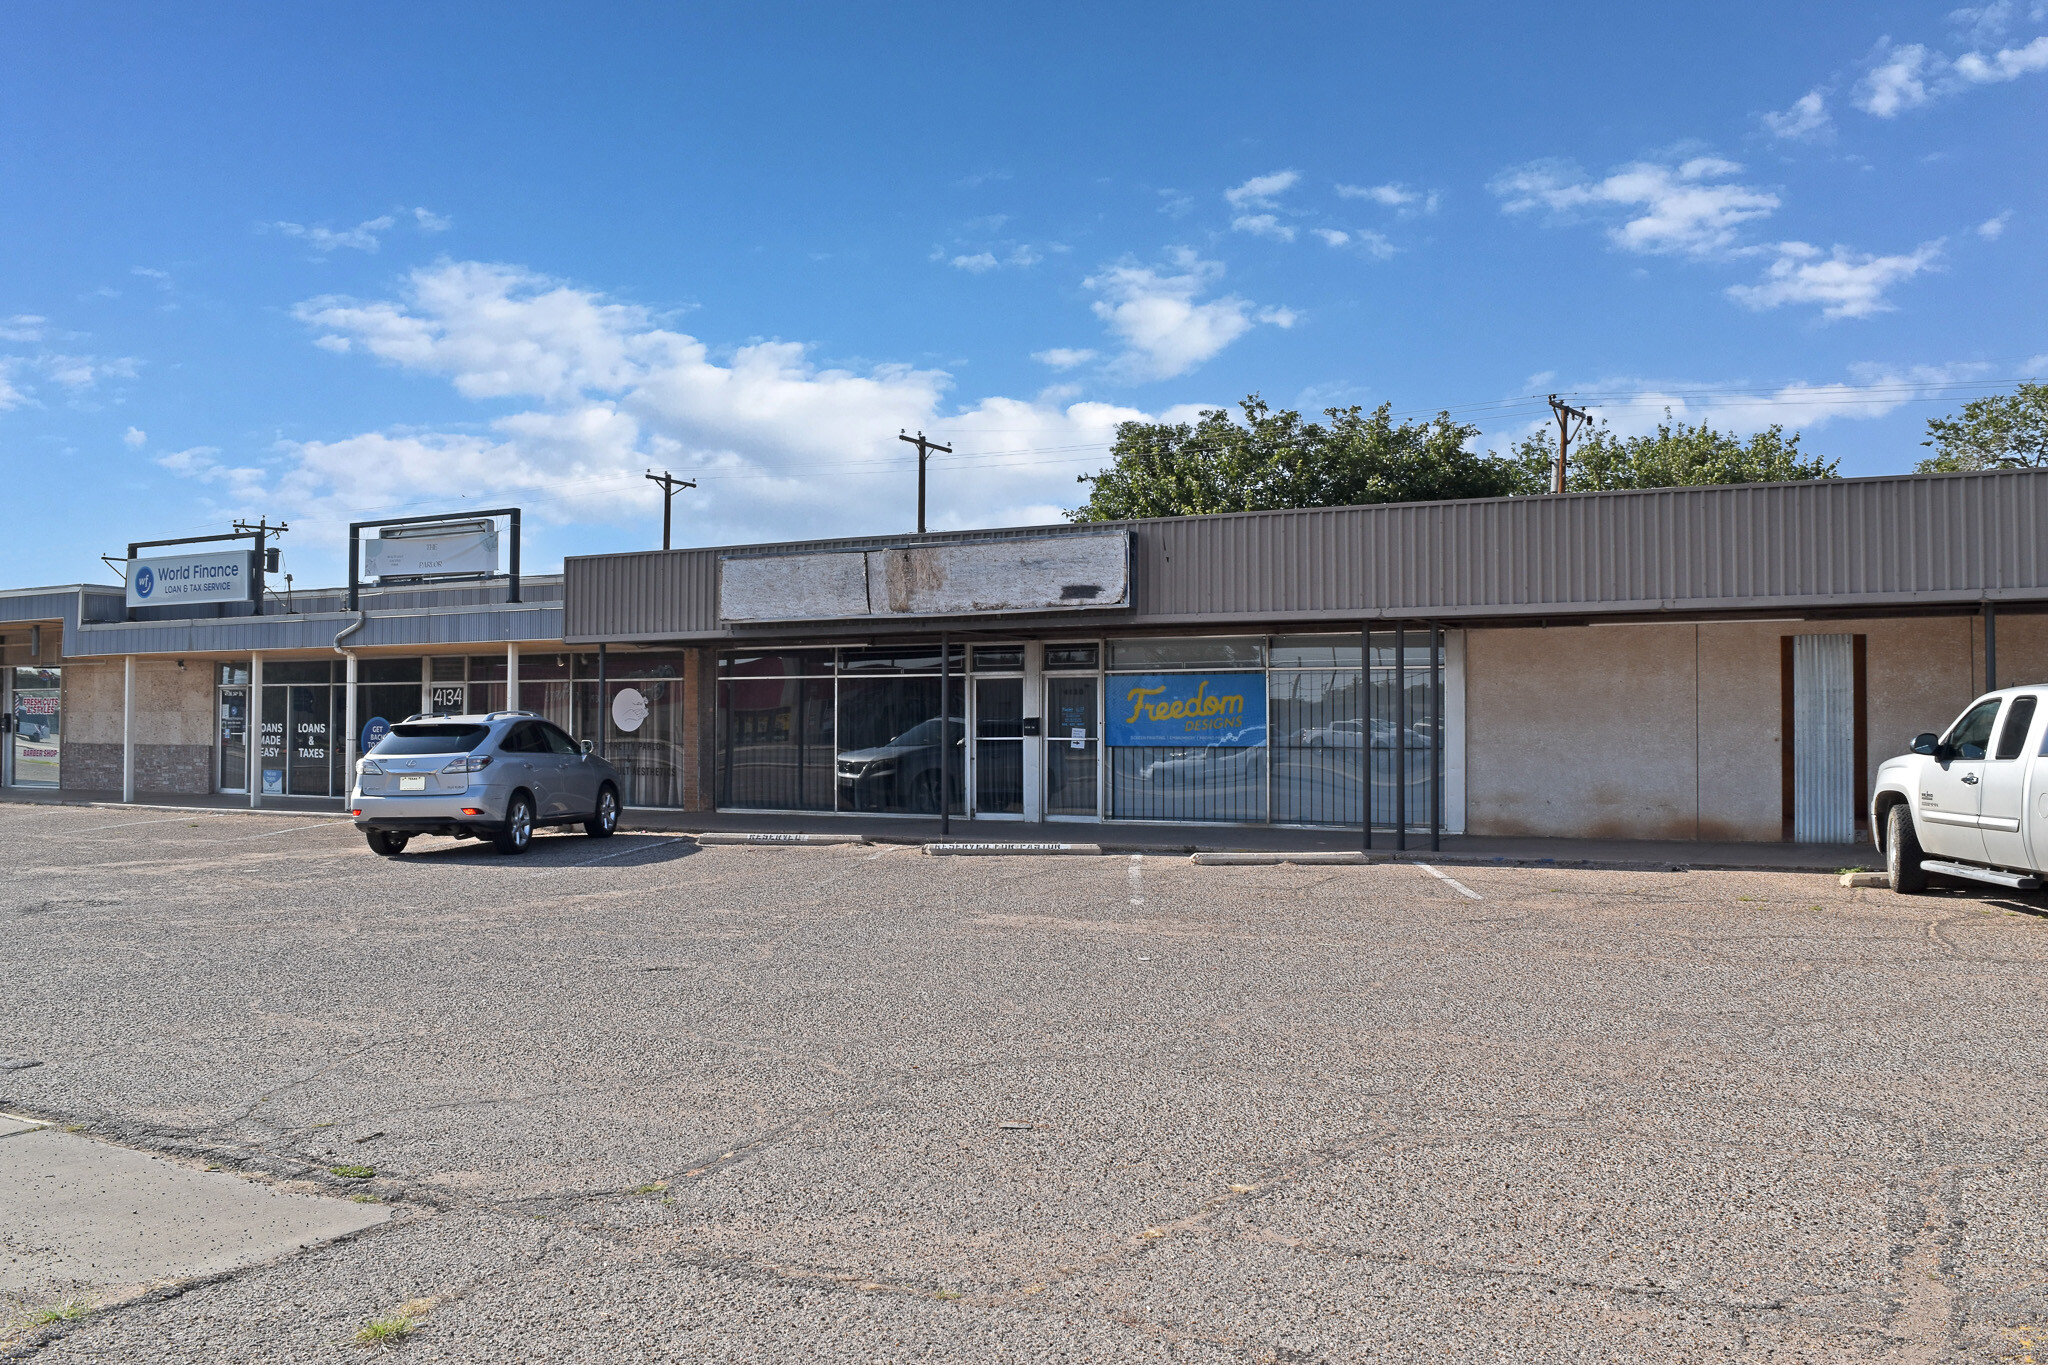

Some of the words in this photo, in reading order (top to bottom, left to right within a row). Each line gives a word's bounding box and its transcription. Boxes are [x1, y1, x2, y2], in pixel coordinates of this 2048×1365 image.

[158, 565, 190, 581] World
[193, 564, 239, 578] Finance
[165, 584, 181, 594] LOAN
[183, 584, 188, 592] &
[190, 583, 202, 592] TAX
[203, 581, 231, 591] SERVICE
[23, 697, 42, 706] FRESH
[43, 697, 59, 706] CUTS
[433, 688, 462, 706] 4134
[1126, 680, 1244, 724] Freedom
[26, 706, 32, 714] &
[32, 706, 55, 714] STYLES
[261, 723, 283, 733] OANS
[297, 723, 326, 733] LOANS
[372, 725, 383, 733] GET
[1185, 716, 1243, 732] DESIGNS
[308, 735, 315, 746] &
[610, 742, 635, 750] PRETTY
[639, 742, 666, 751] PARLOR
[23, 749, 42, 757] BARBER
[298, 748, 325, 759] TAXES
[632, 767, 677, 777] AESTHETICS
